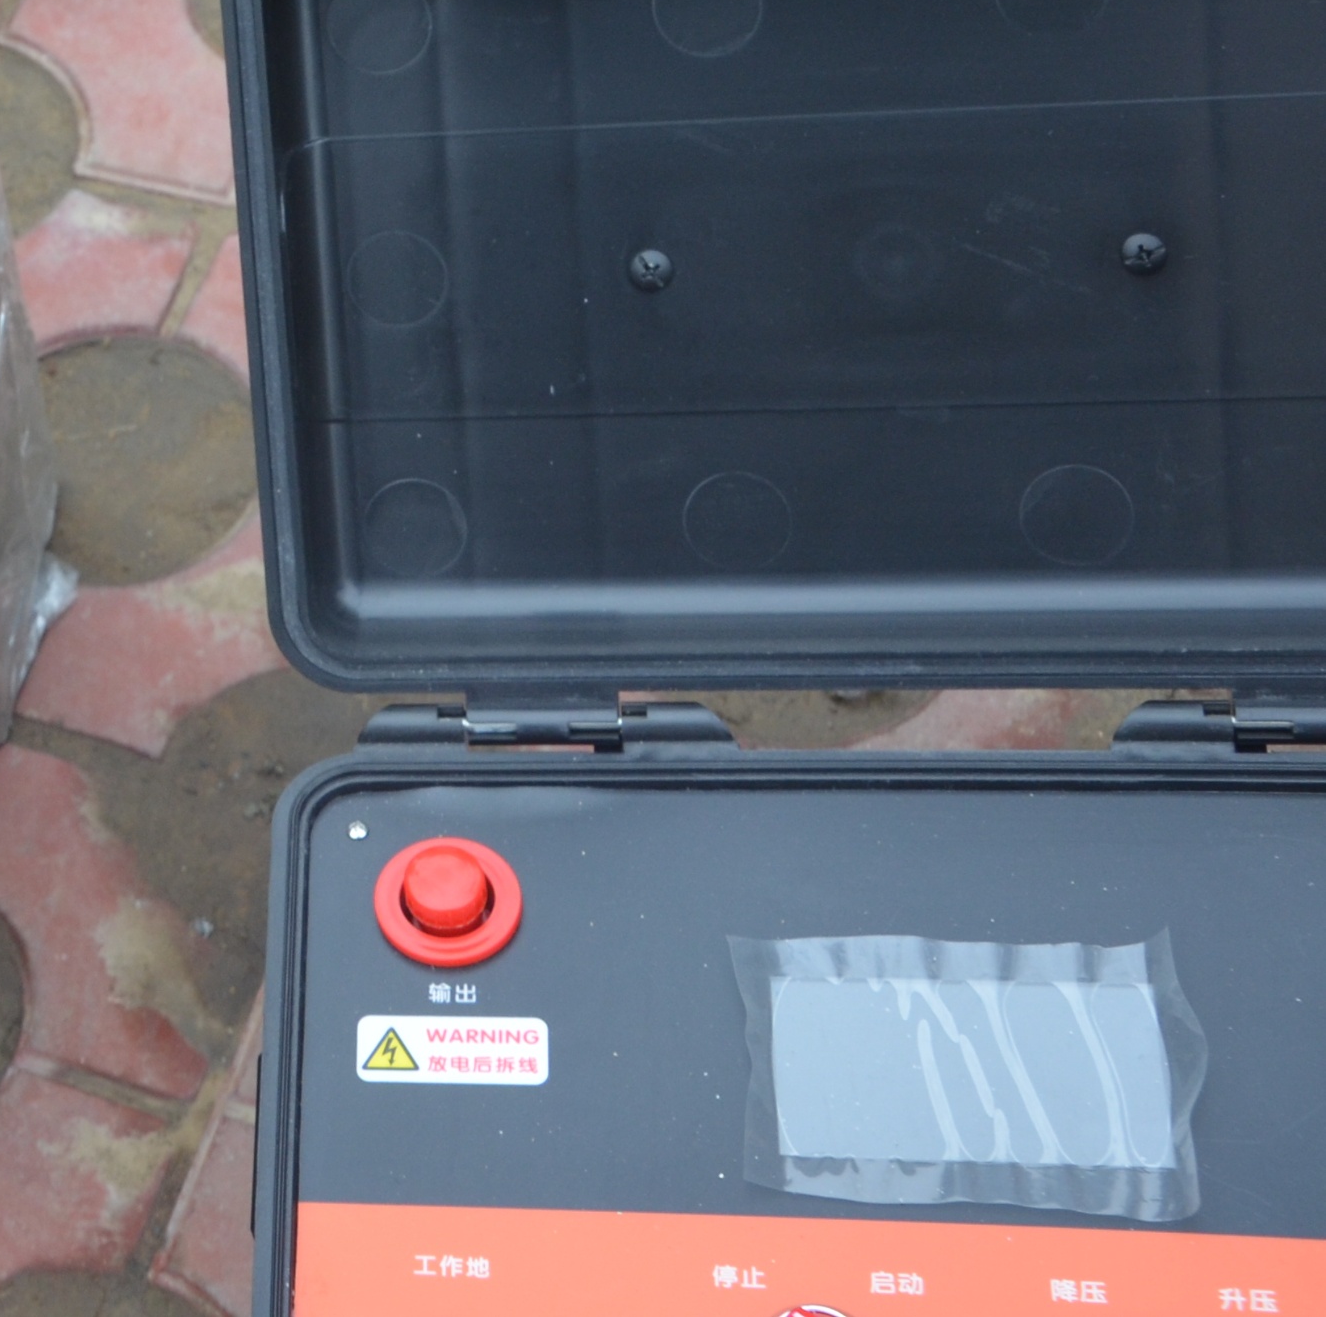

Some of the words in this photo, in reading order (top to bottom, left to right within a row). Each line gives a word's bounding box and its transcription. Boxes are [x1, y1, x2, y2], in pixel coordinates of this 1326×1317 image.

[428, 983, 477, 1003] 输出
[427, 1028, 539, 1044] WARNING
[428, 1056, 538, 1073] 放电后拆线
[413, 1254, 490, 1278] 工作地
[712, 1264, 767, 1289] 停止
[870, 1270, 924, 1295] 启动
[1049, 1278, 1108, 1304] 降压
[1218, 1287, 1280, 1312] 升压
